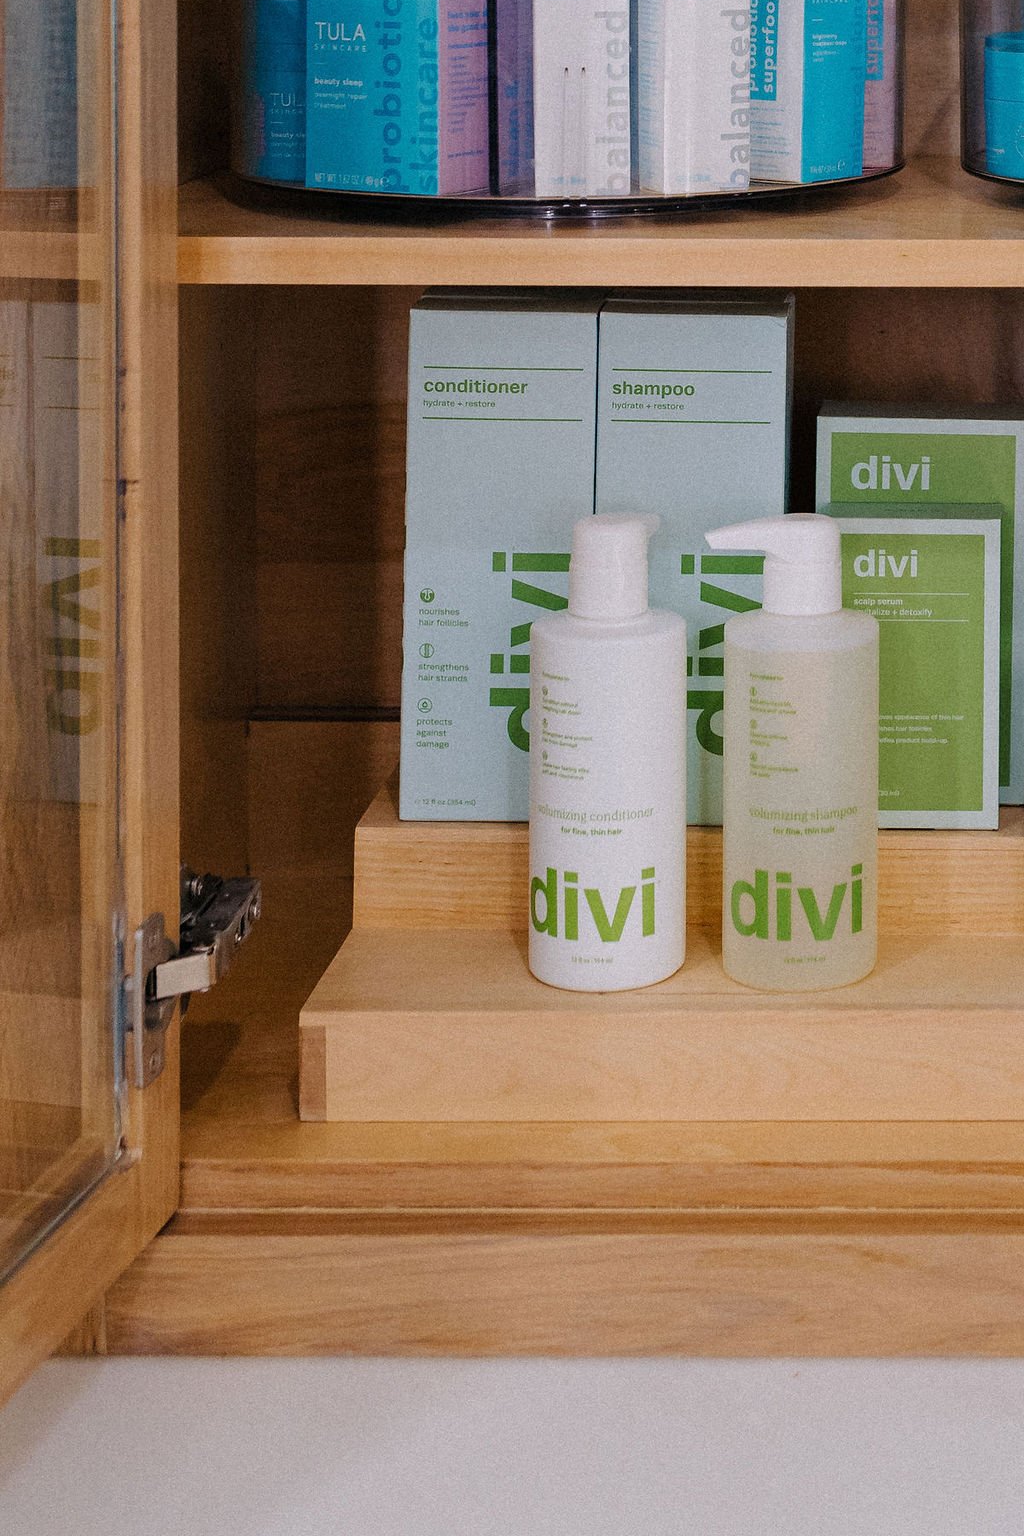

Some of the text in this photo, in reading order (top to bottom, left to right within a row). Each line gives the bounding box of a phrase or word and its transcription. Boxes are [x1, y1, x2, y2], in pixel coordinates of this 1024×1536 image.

[314, 22, 366, 41] TULA
[314, 77, 340, 86] beauty
[719, 9, 750, 190] balanced
[424, 378, 528, 394] conditioner
[612, 381, 695, 399] shampoo
[423, 399, 496, 408] hydrate restore
[612, 401, 684, 411] hydrate restore
[850, 454, 931, 492] divi
[853, 548, 918, 578] divi
[854, 597, 876, 606] scalp
[419, 608, 460, 616] nourishes
[899, 608, 933, 617] detoxify
[437, 619, 469, 627] follicles
[418, 663, 469, 673] strengthens
[416, 719, 453, 727] protects
[416, 730, 447, 738] against
[416, 740, 450, 749] damage
[590, 806, 654, 821] conditioner
[811, 806, 858, 821] shampoo
[561, 826, 622, 836] for fine, thin hair
[773, 827, 835, 836] for fine, hair
[531, 866, 655, 943] divi
[730, 862, 863, 942] divi
